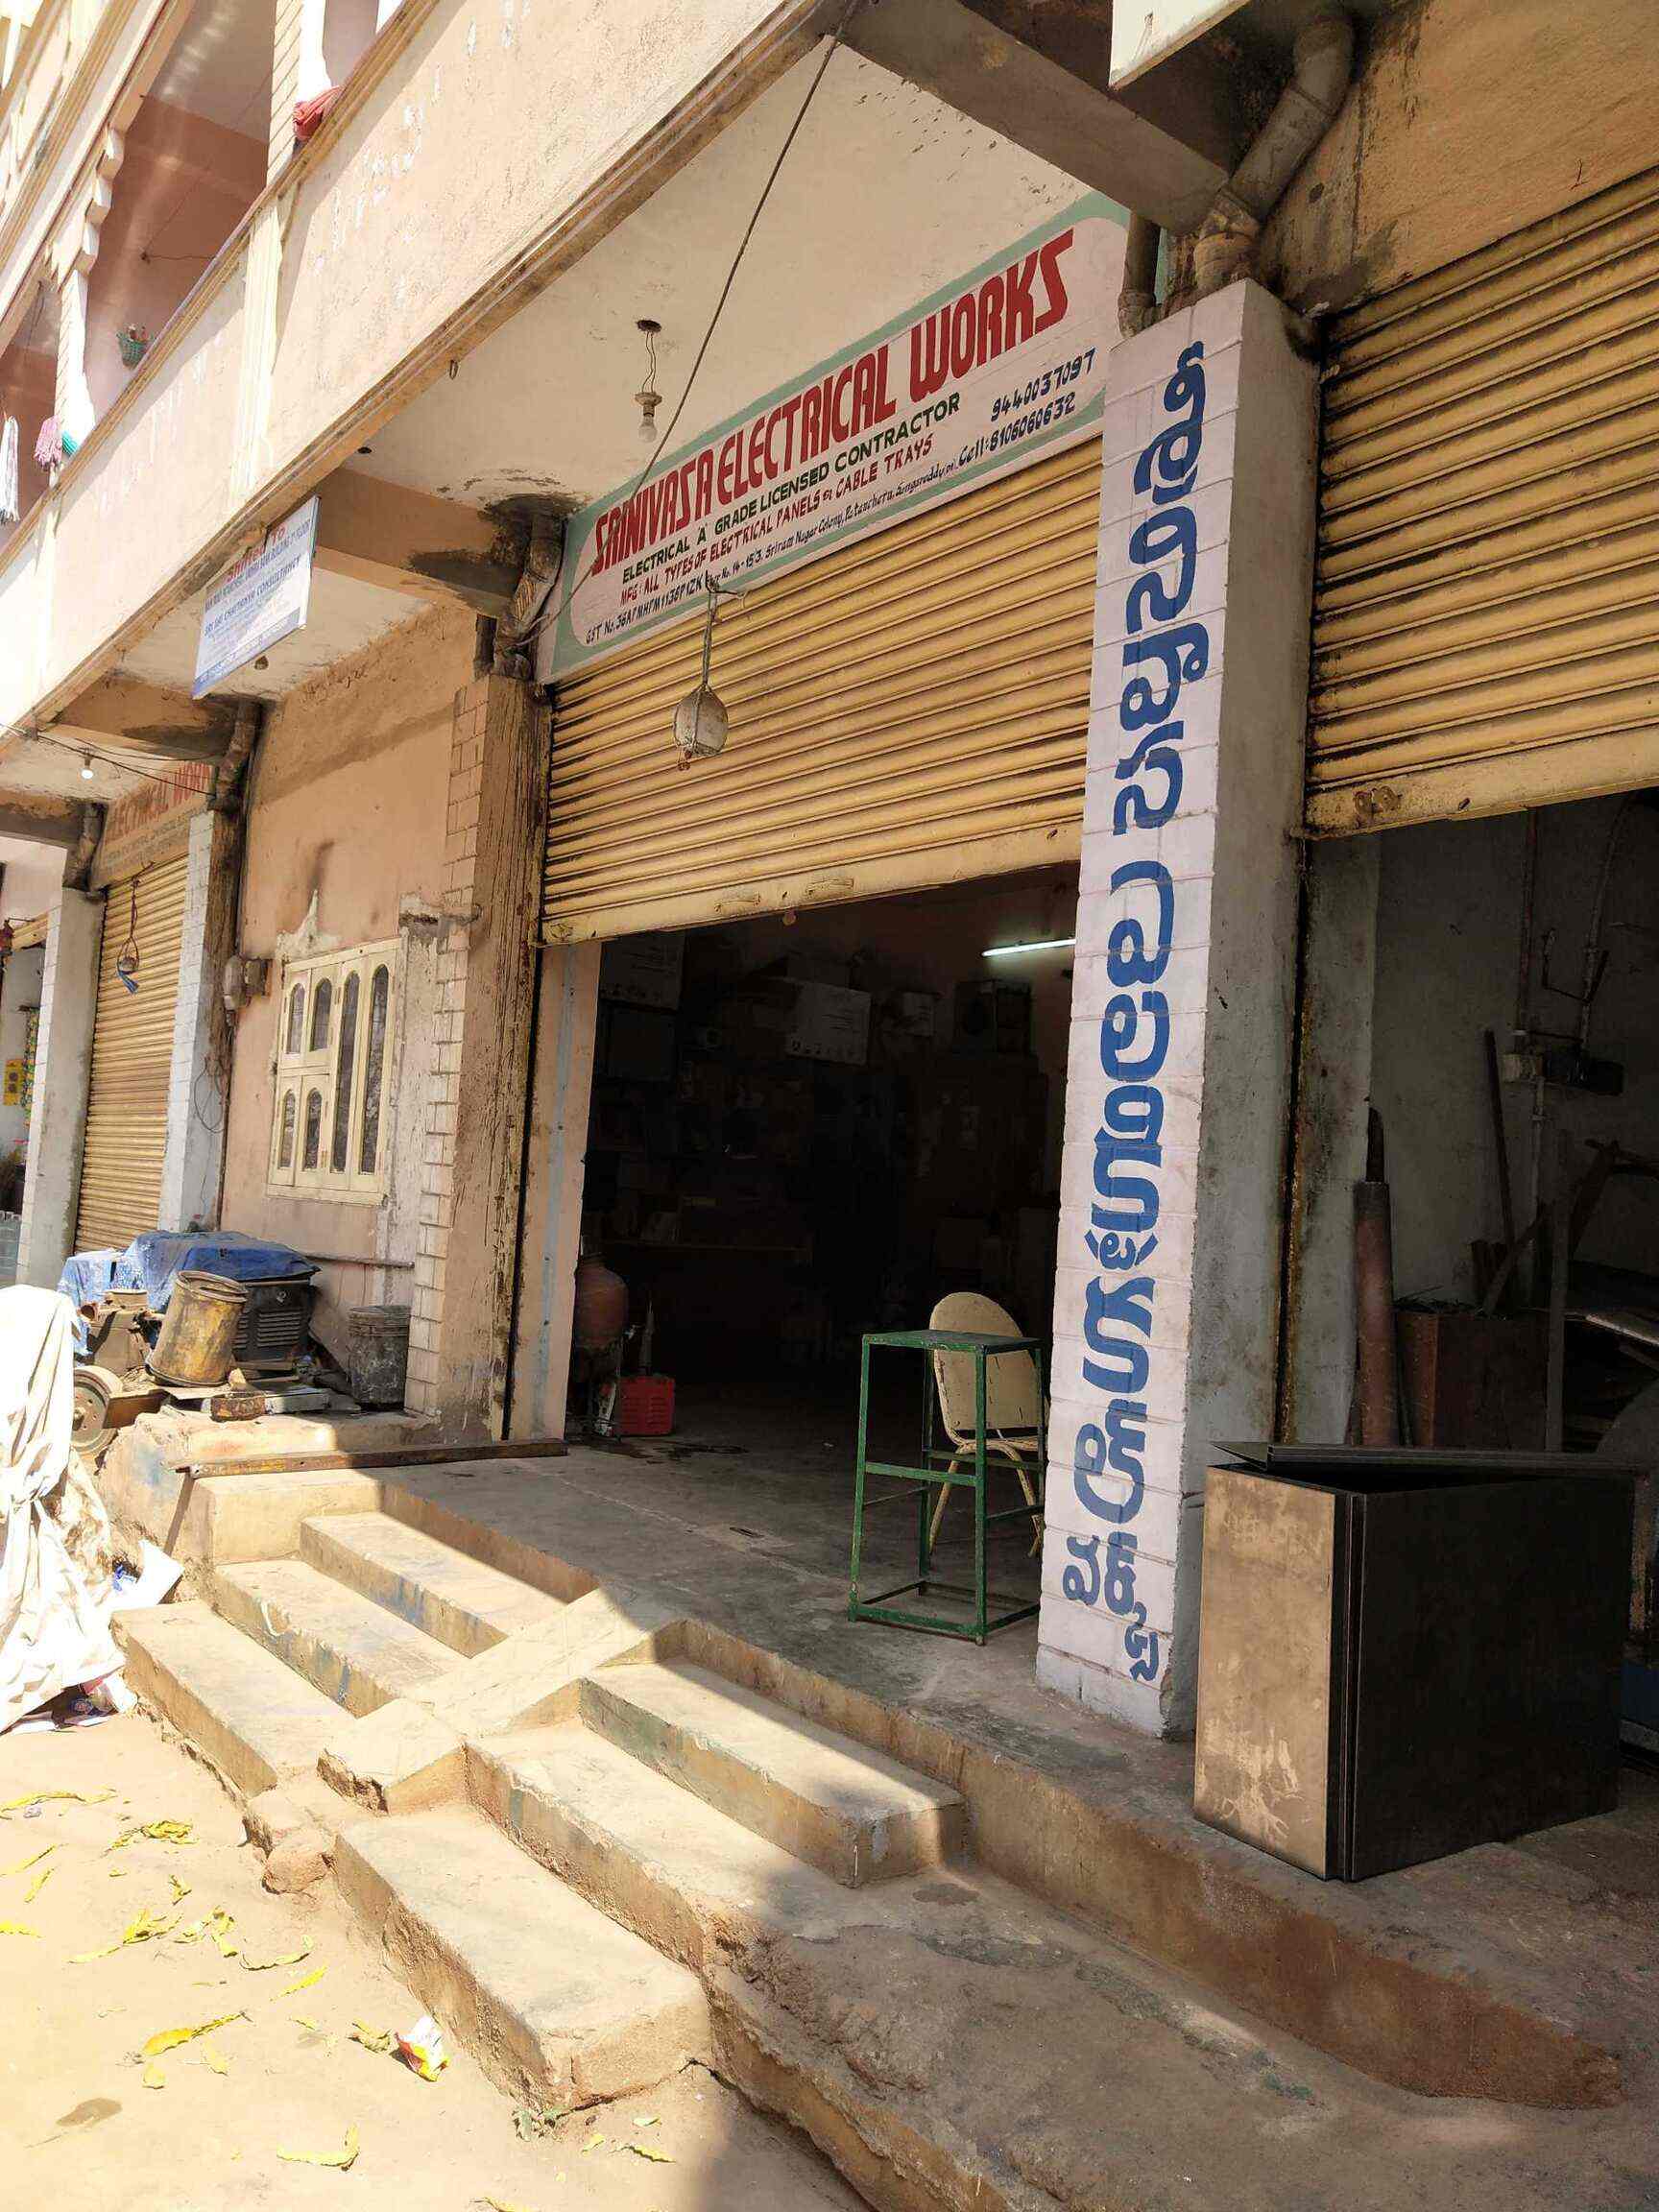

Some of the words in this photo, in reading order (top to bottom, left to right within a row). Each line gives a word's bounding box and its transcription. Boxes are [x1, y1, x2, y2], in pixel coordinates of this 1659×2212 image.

[591, 448, 713, 576] SRINIVASA
[717, 344, 897, 505] ELECTRICAL
[909, 228, 1073, 403] WORKS
[991, 347, 1096, 422] 9440037097
[622, 537, 690, 584] ELECTRICAL
[715, 499, 757, 535] GRADE
[759, 462, 830, 513] LICENSED
[834, 392, 960, 472] CONTRACTOR
[644, 574, 660, 594] ALL
[664, 554, 693, 585] TYPES
[694, 548, 708, 569] OF
[710, 515, 773, 563] ELECTRICAL
[776, 490, 821, 528] PANELS
[835, 461, 878, 498] CABLE
[883, 433, 933, 474] TRAYS
[586, 623, 602, 644] GST
